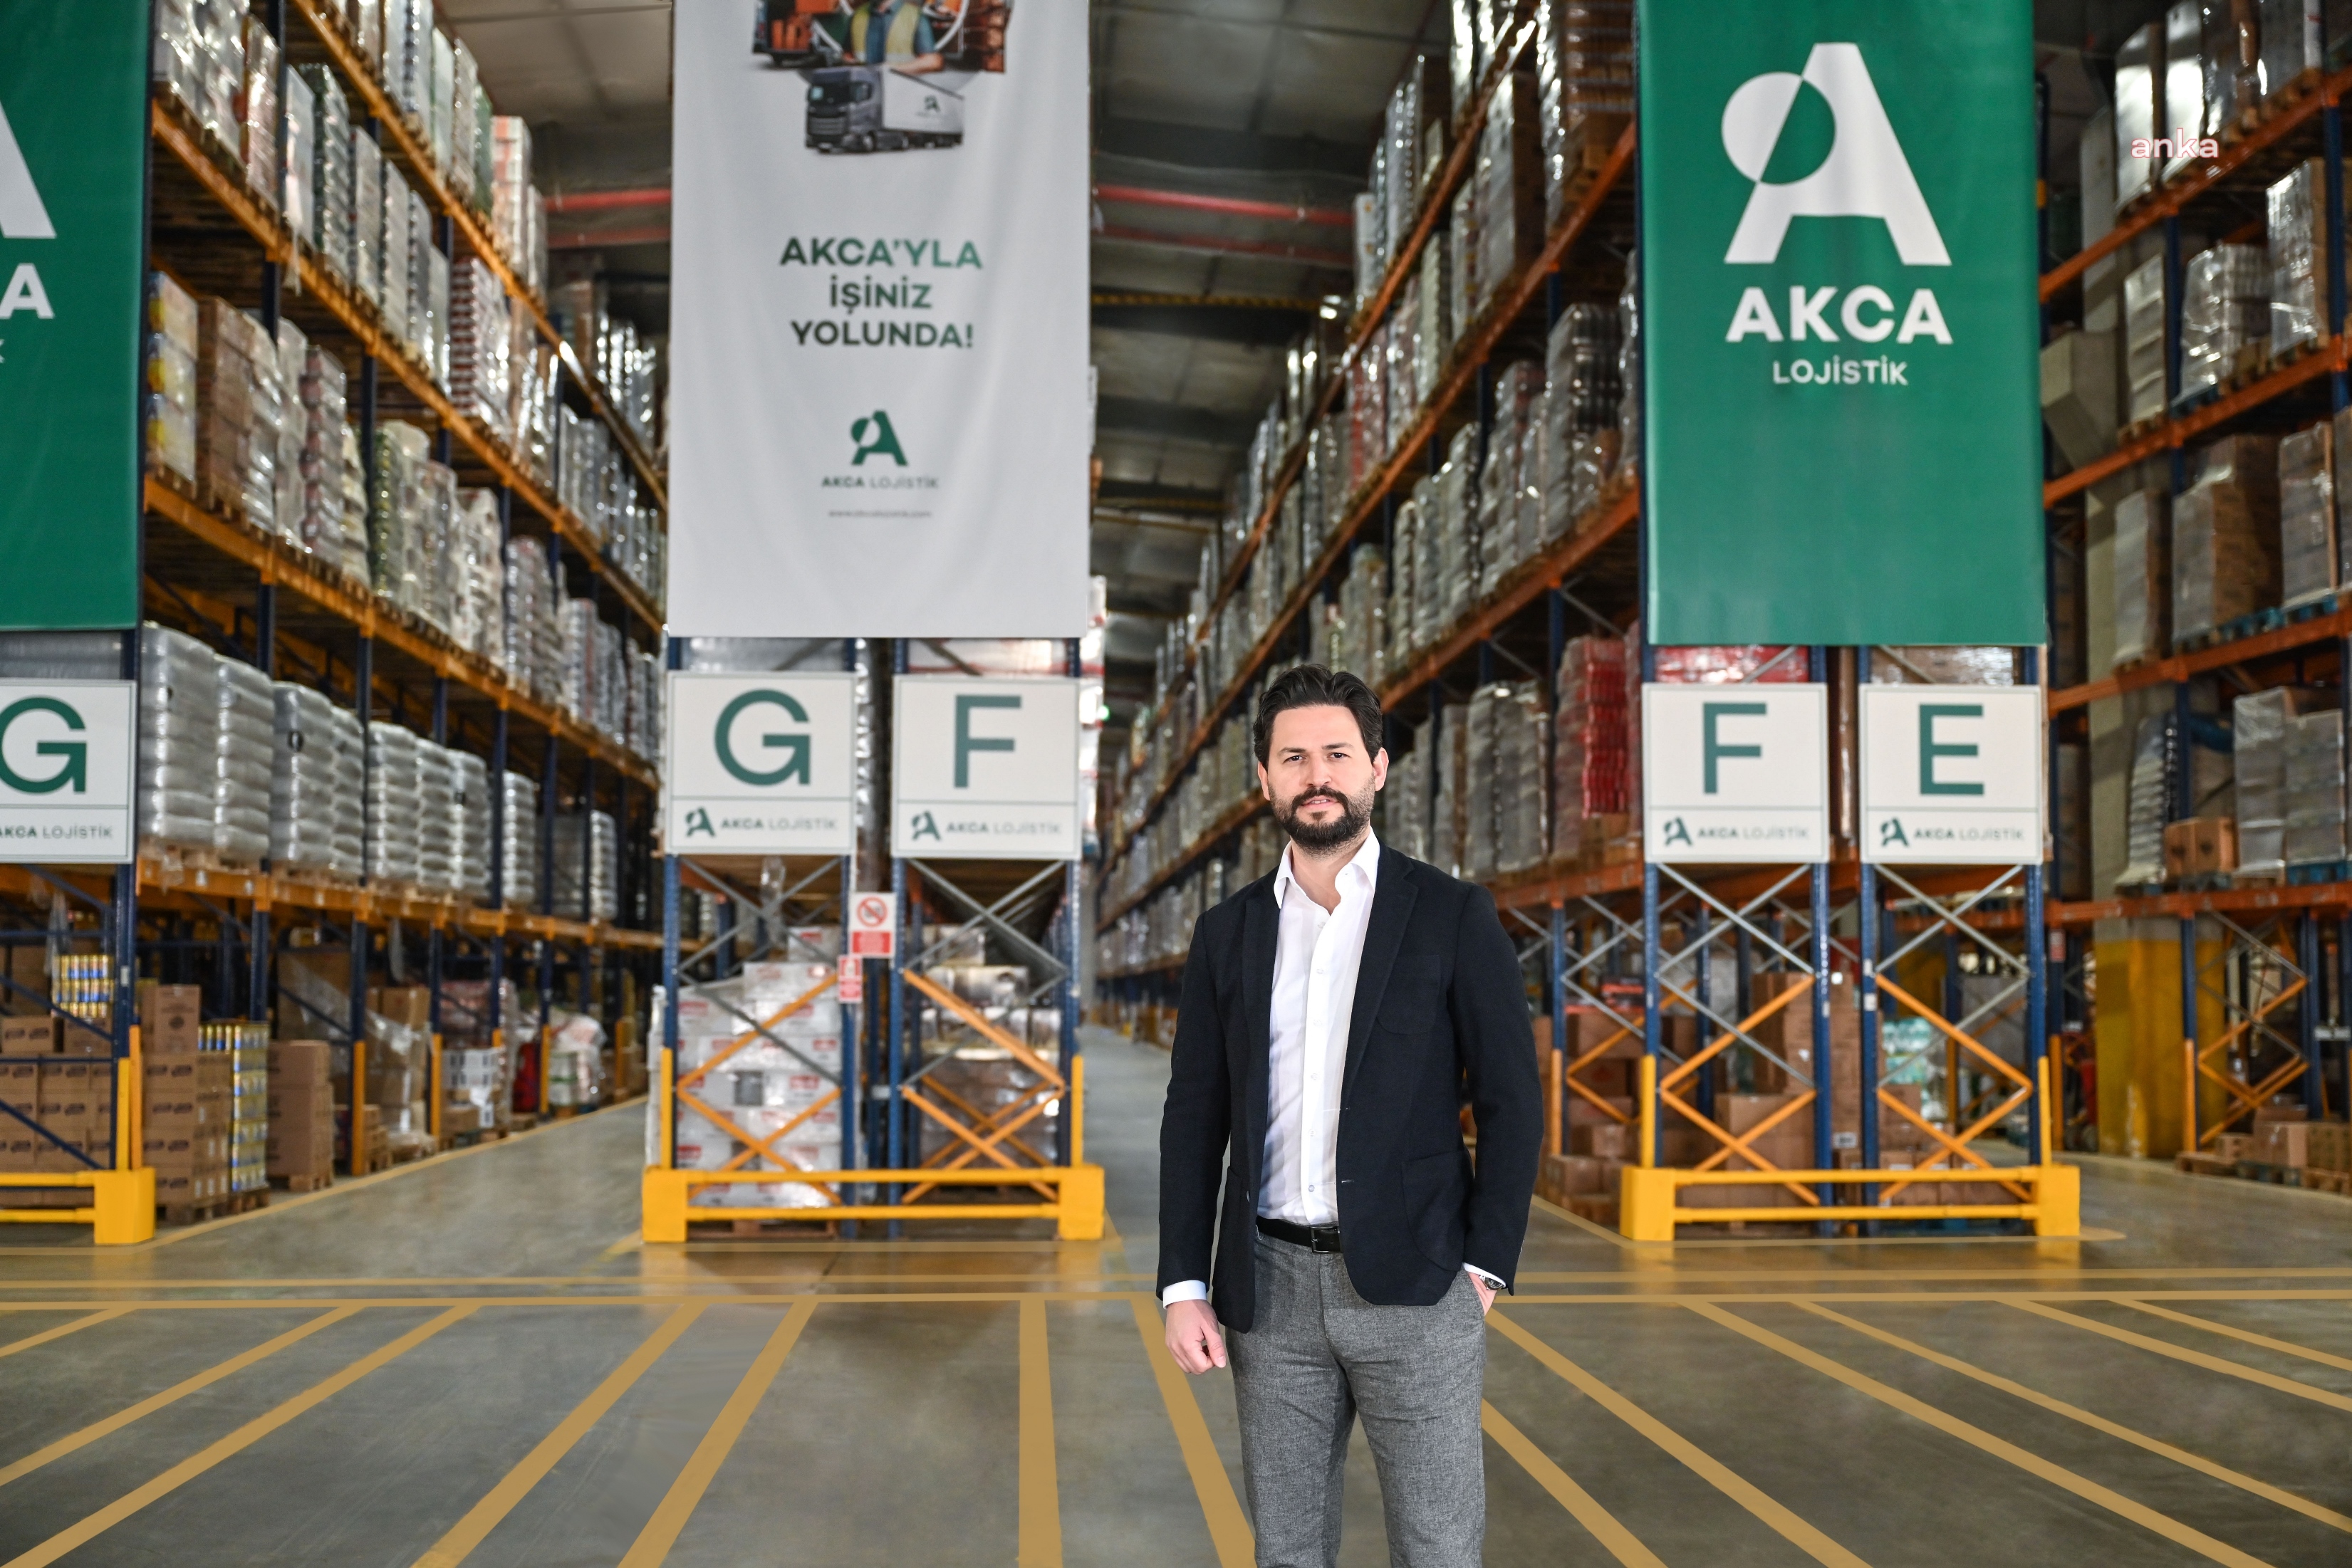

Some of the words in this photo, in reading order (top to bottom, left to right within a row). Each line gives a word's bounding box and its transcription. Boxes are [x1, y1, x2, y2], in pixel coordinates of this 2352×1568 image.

[830, 273, 932, 315] İŞİNİZ
[1724, 284, 1955, 345] AKCA
[791, 320, 974, 348] YOLUNDA!
[1772, 355, 1909, 385] LOJİSTİK
[822, 476, 865, 488] AKCA
[0, 695, 87, 795] G
[714, 688, 811, 787] G
[953, 694, 1022, 789] F
[1702, 702, 1768, 795] F
[1919, 704, 1984, 795] E
[42, 825, 113, 839] LOJİSTİK
[721, 818, 764, 830] AKCA
[769, 816, 838, 831] LOJİSTİK
[947, 822, 989, 834] AKCA
[993, 820, 1062, 835] LOJİSTİK
[1697, 827, 1738, 839] AKCA
[1742, 825, 1808, 840] LOJİSTİK
[1913, 828, 1955, 840] AKCA
[1960, 826, 2024, 841] LOJİSTİK
